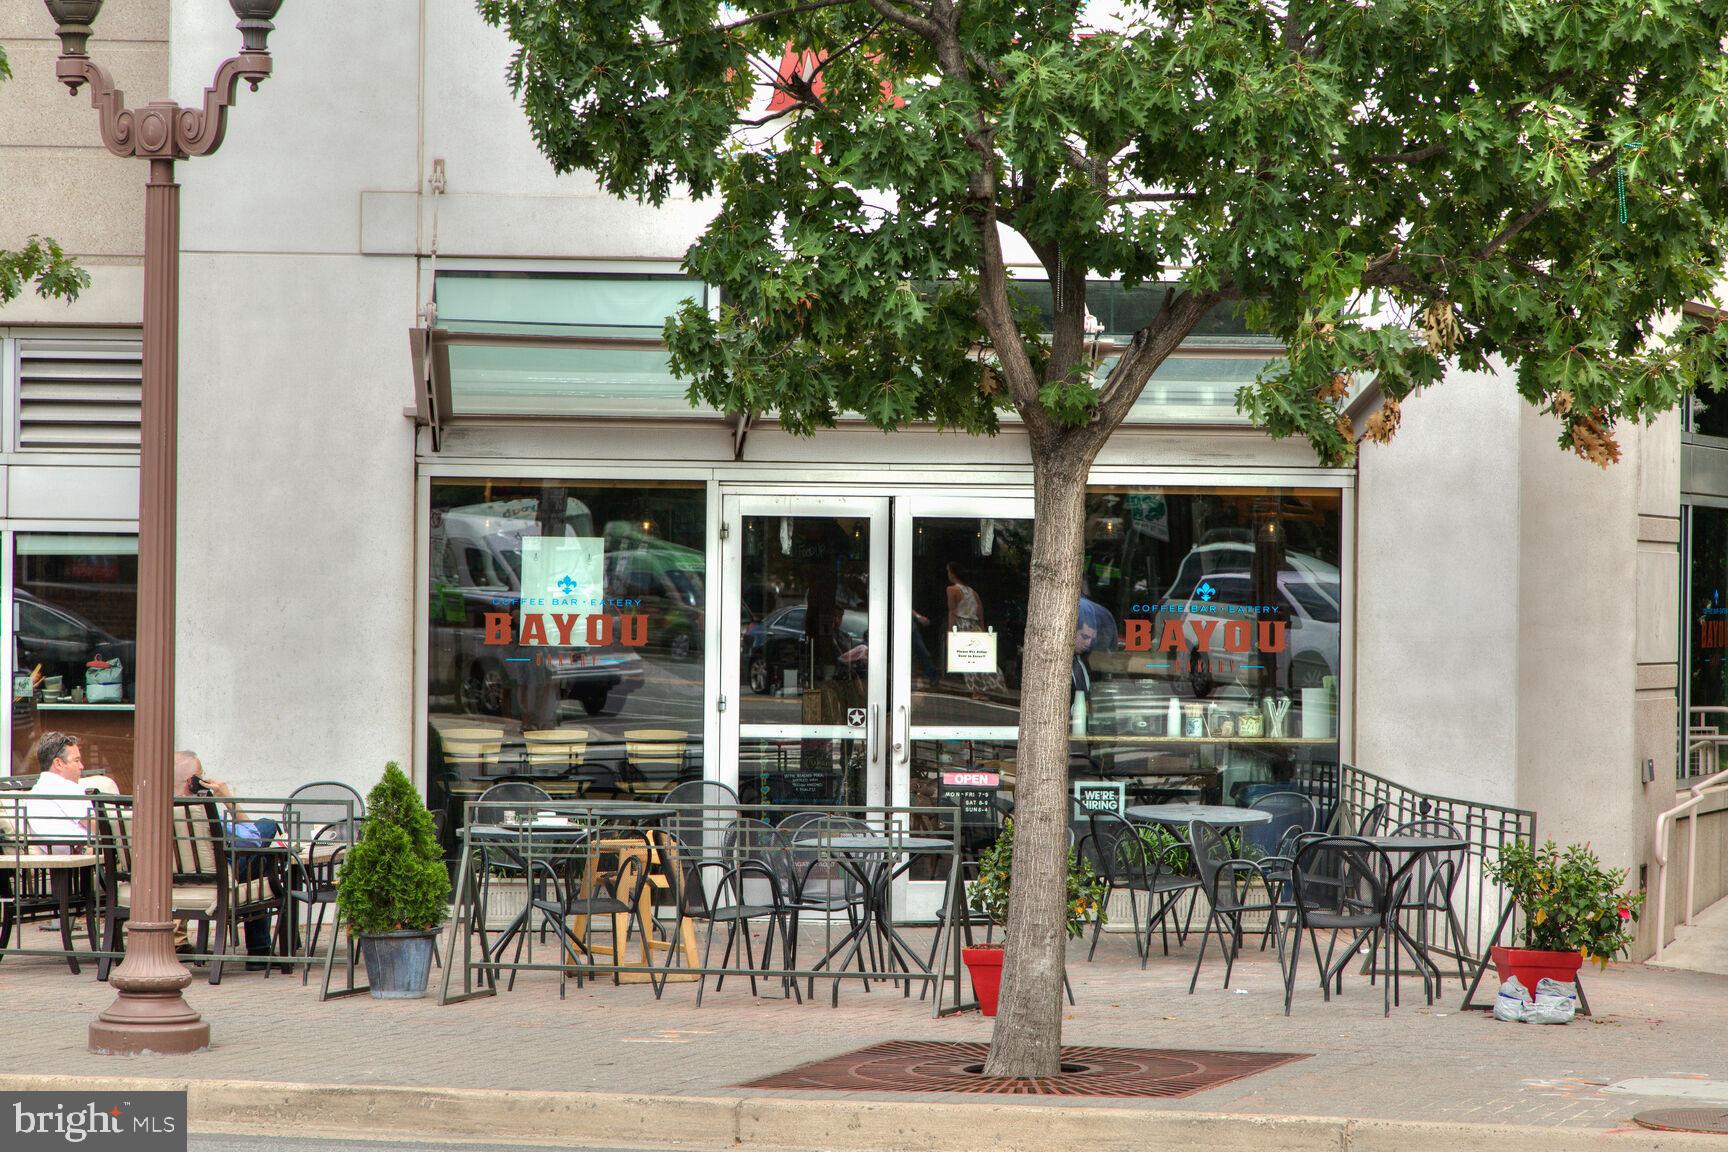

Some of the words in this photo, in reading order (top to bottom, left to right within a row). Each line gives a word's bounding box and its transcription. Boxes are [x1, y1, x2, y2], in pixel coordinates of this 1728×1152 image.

[492, 598, 545, 606] COFFEE
[552, 598, 578, 606] BAR
[590, 598, 642, 607] EATERY
[1132, 604, 1184, 613] COFFEE
[1190, 604, 1216, 613] BAR
[1228, 605, 1280, 614] EATERY
[484, 613, 649, 646] BAYOU
[1124, 619, 1287, 653] BAYOU
[954, 774, 988, 784] OPEN
[1084, 790, 1115, 800] WE'RE
[1082, 800, 1118, 810] HIRING
